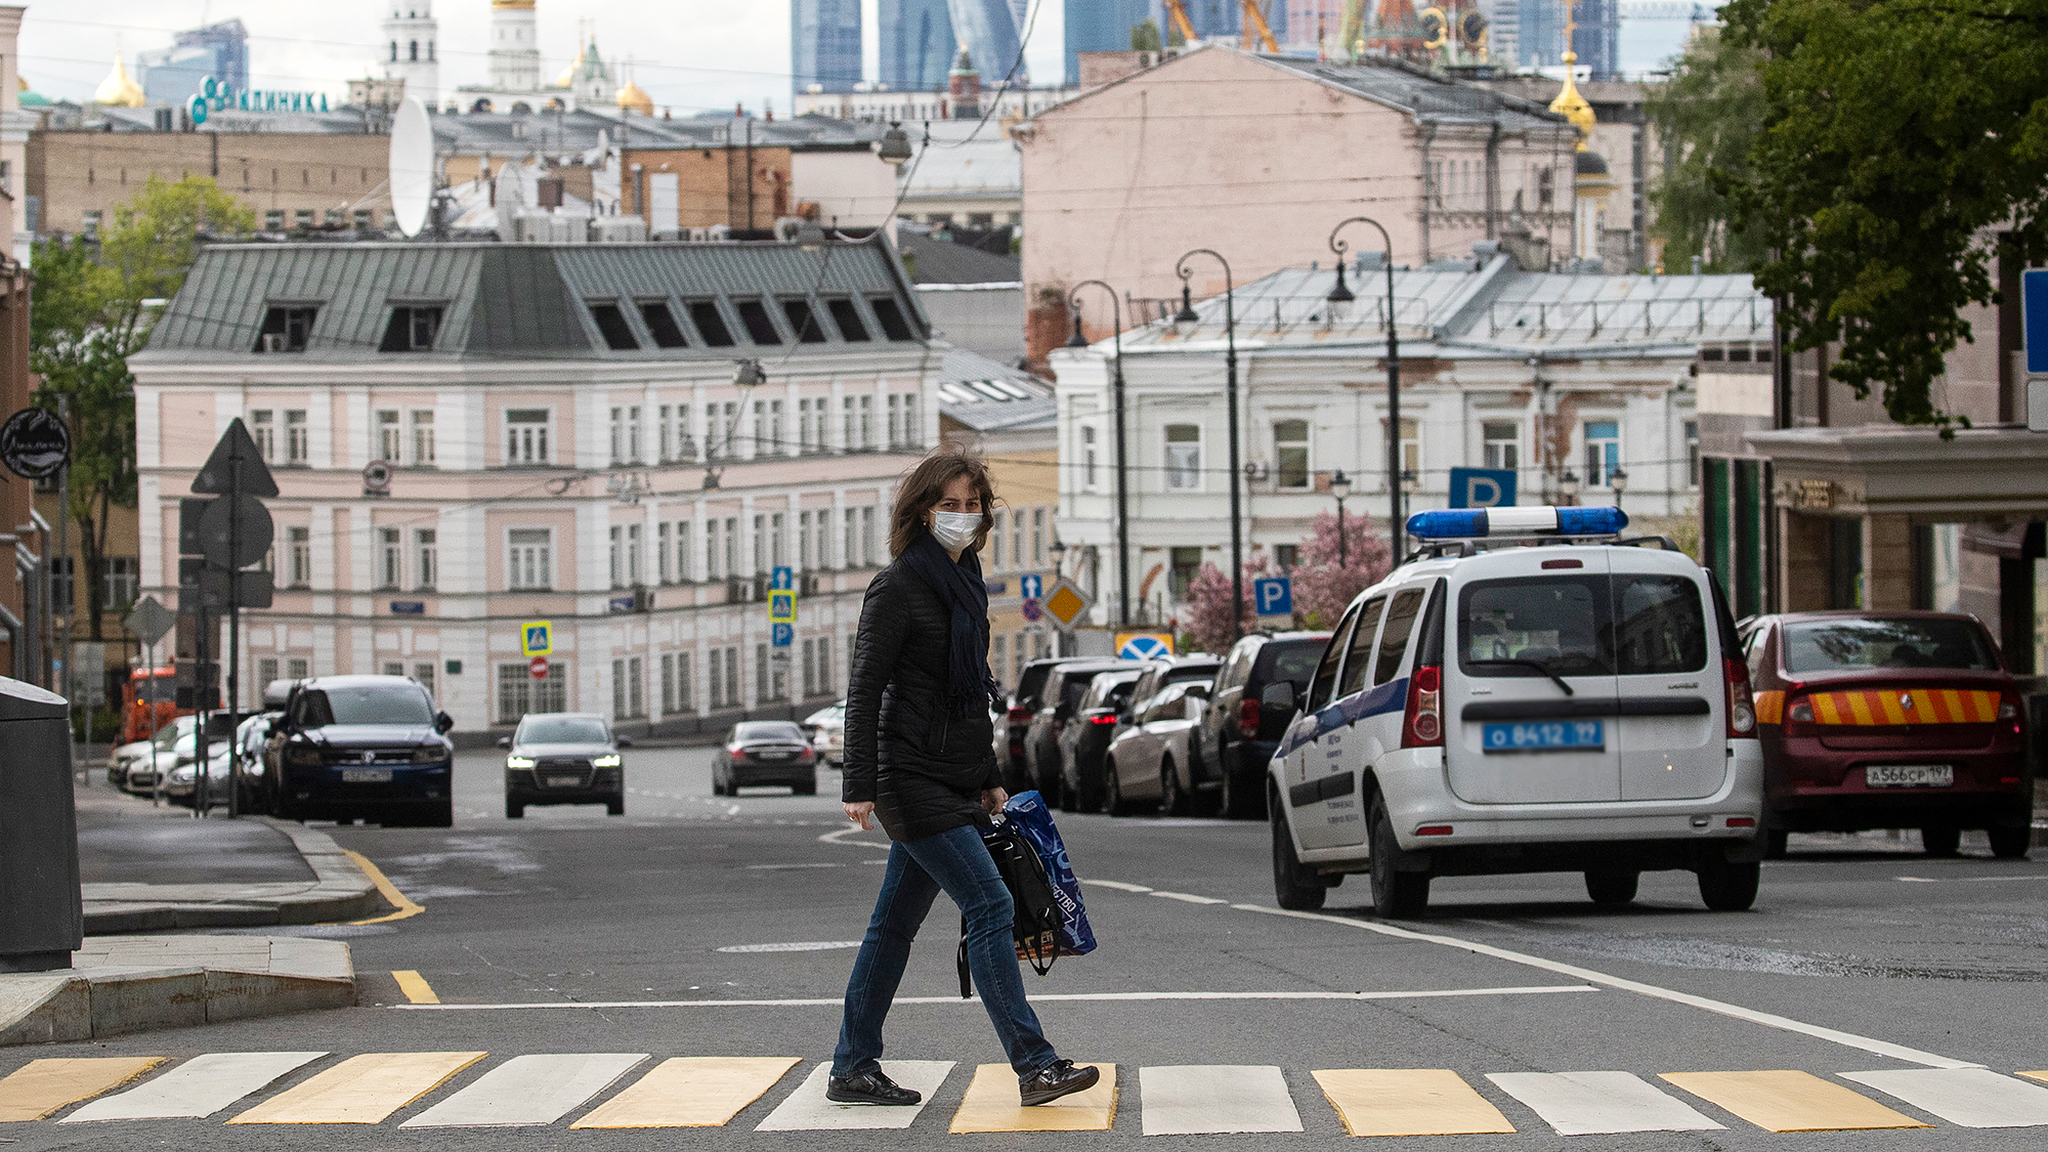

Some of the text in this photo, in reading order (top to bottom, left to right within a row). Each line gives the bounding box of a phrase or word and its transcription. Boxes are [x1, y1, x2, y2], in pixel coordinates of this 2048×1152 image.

[240, 89, 328, 112] КЛИНИКА
[1263, 582, 1283, 611] P
[776, 623, 788, 646] P
[1512, 722, 1565, 746] 8412
